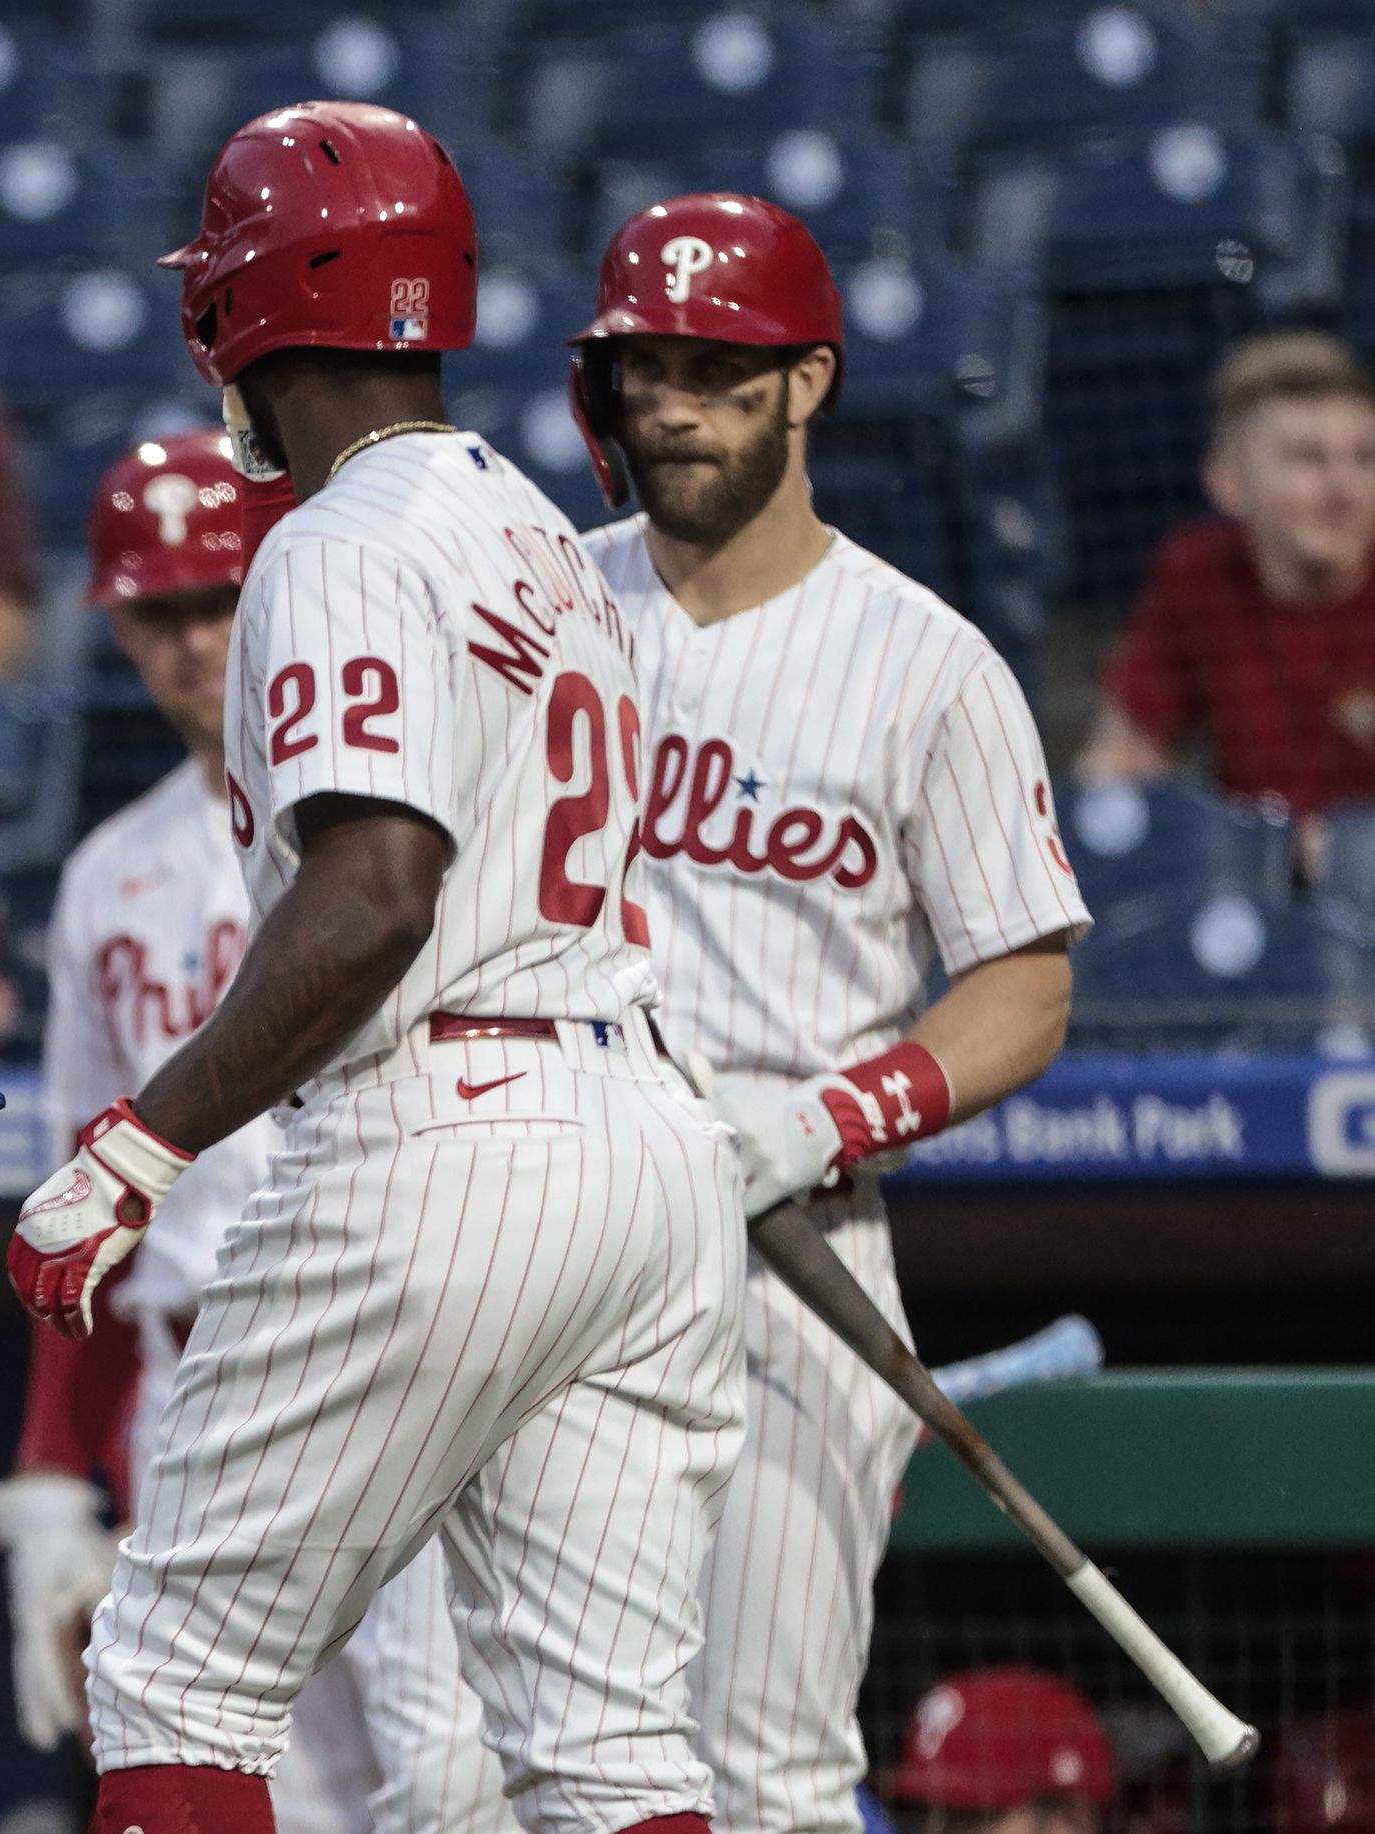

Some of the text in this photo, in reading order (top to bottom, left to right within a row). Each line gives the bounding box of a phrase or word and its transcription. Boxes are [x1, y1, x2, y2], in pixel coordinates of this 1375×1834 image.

[390, 277, 430, 316] 22
[660, 235, 714, 304] P
[268, 657, 399, 766] 22
[641, 734, 879, 889] llies
[1005, 1096, 1123, 1164] Bank
[1132, 1095, 1244, 1163] Park
